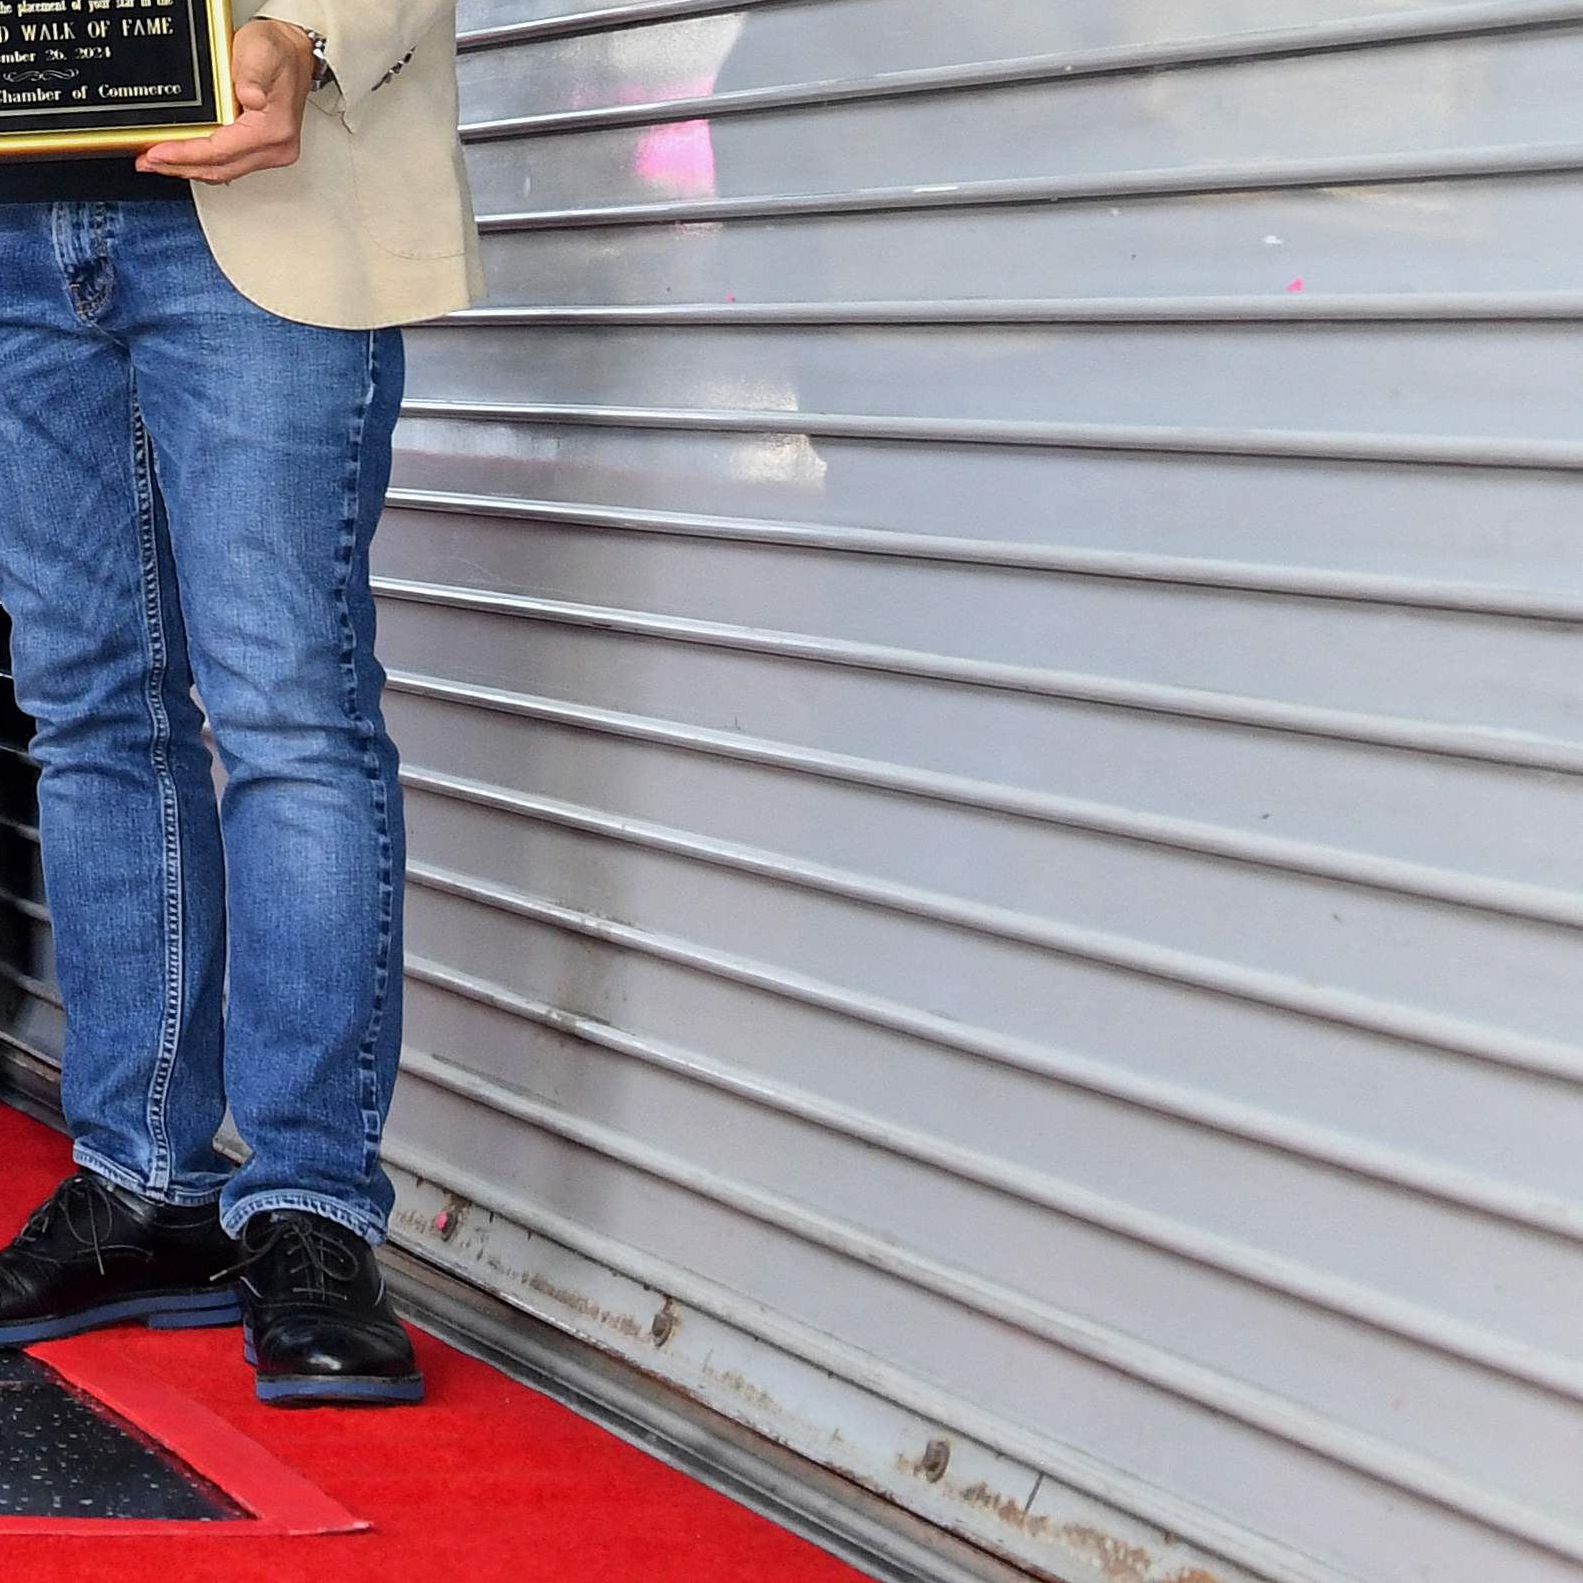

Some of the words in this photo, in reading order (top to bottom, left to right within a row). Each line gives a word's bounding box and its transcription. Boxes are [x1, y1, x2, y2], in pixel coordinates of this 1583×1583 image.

[17, 0, 67, 18] placement
[21, 21, 76, 42] WALK
[87, 20, 111, 39] OF
[122, 17, 174, 37] FAME
[75, 46, 112, 60] 2024
[72, 85, 88, 99] of
[98, 82, 182, 98] Commerce
